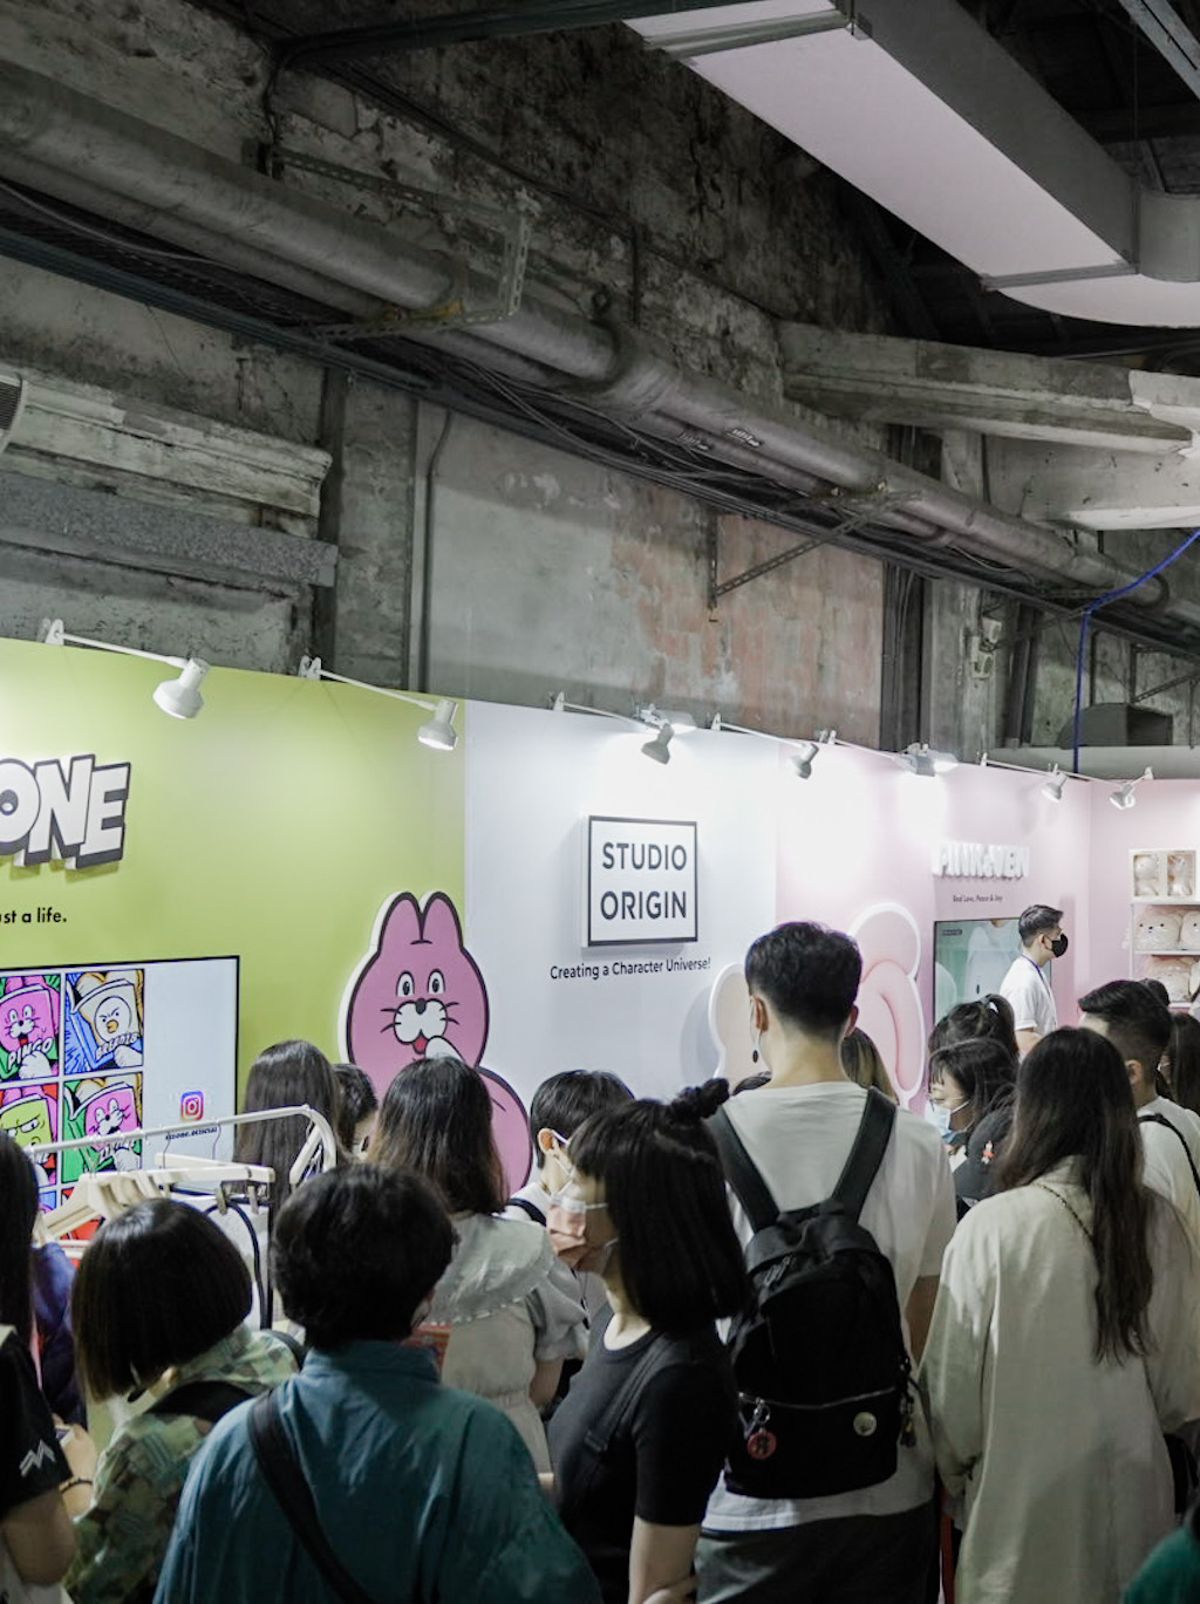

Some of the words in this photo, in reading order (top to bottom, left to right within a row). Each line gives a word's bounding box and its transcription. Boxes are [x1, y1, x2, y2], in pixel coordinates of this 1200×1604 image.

[602, 841, 688, 871] STUDIO
[0, 909, 17, 924] st
[21, 913, 32, 923] a
[37, 906, 68, 924] life.
[600, 890, 688, 920] ORIGIN
[550, 962, 600, 981] Creating
[602, 966, 610, 976] a
[612, 959, 664, 976] Character
[666, 956, 712, 973] Universe!
